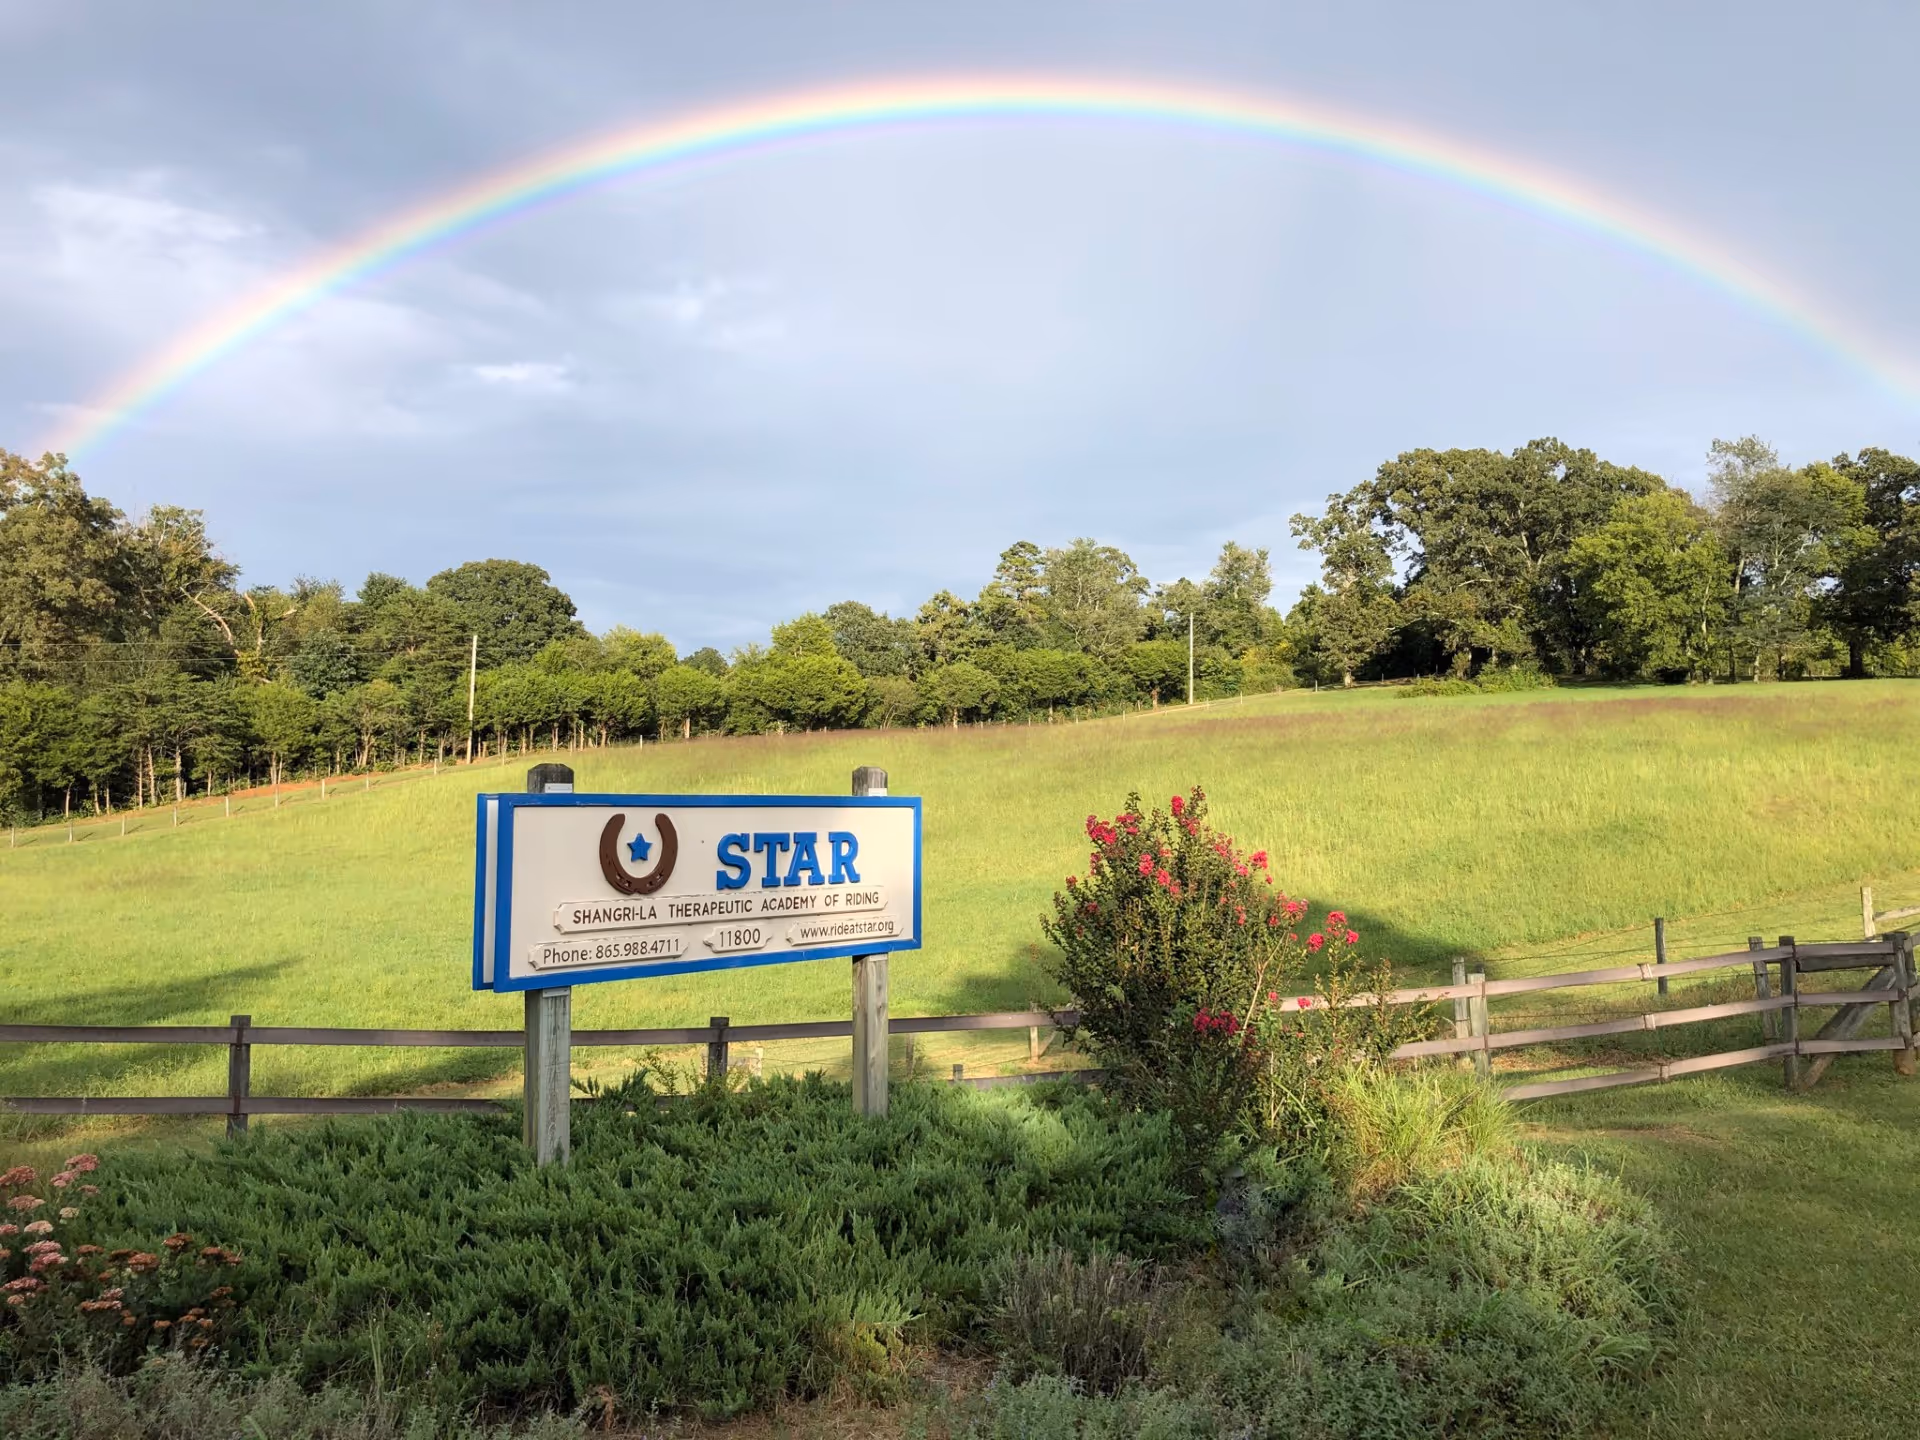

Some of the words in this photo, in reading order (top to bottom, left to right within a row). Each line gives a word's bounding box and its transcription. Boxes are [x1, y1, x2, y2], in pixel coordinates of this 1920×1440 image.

[716, 831, 861, 890] STAR
[573, 905, 657, 924] SHANGRI-LA
[668, 899, 753, 918] THERAPEUTIC
[761, 895, 816, 911] ACADEMY
[824, 893, 839, 907] OF
[845, 891, 879, 907] RIDING
[719, 928, 761, 947] 11800
[800, 920, 894, 938] www.rideatstar.org
[543, 947, 593, 964] Phone:
[595, 938, 679, 959] 865.988.4711
